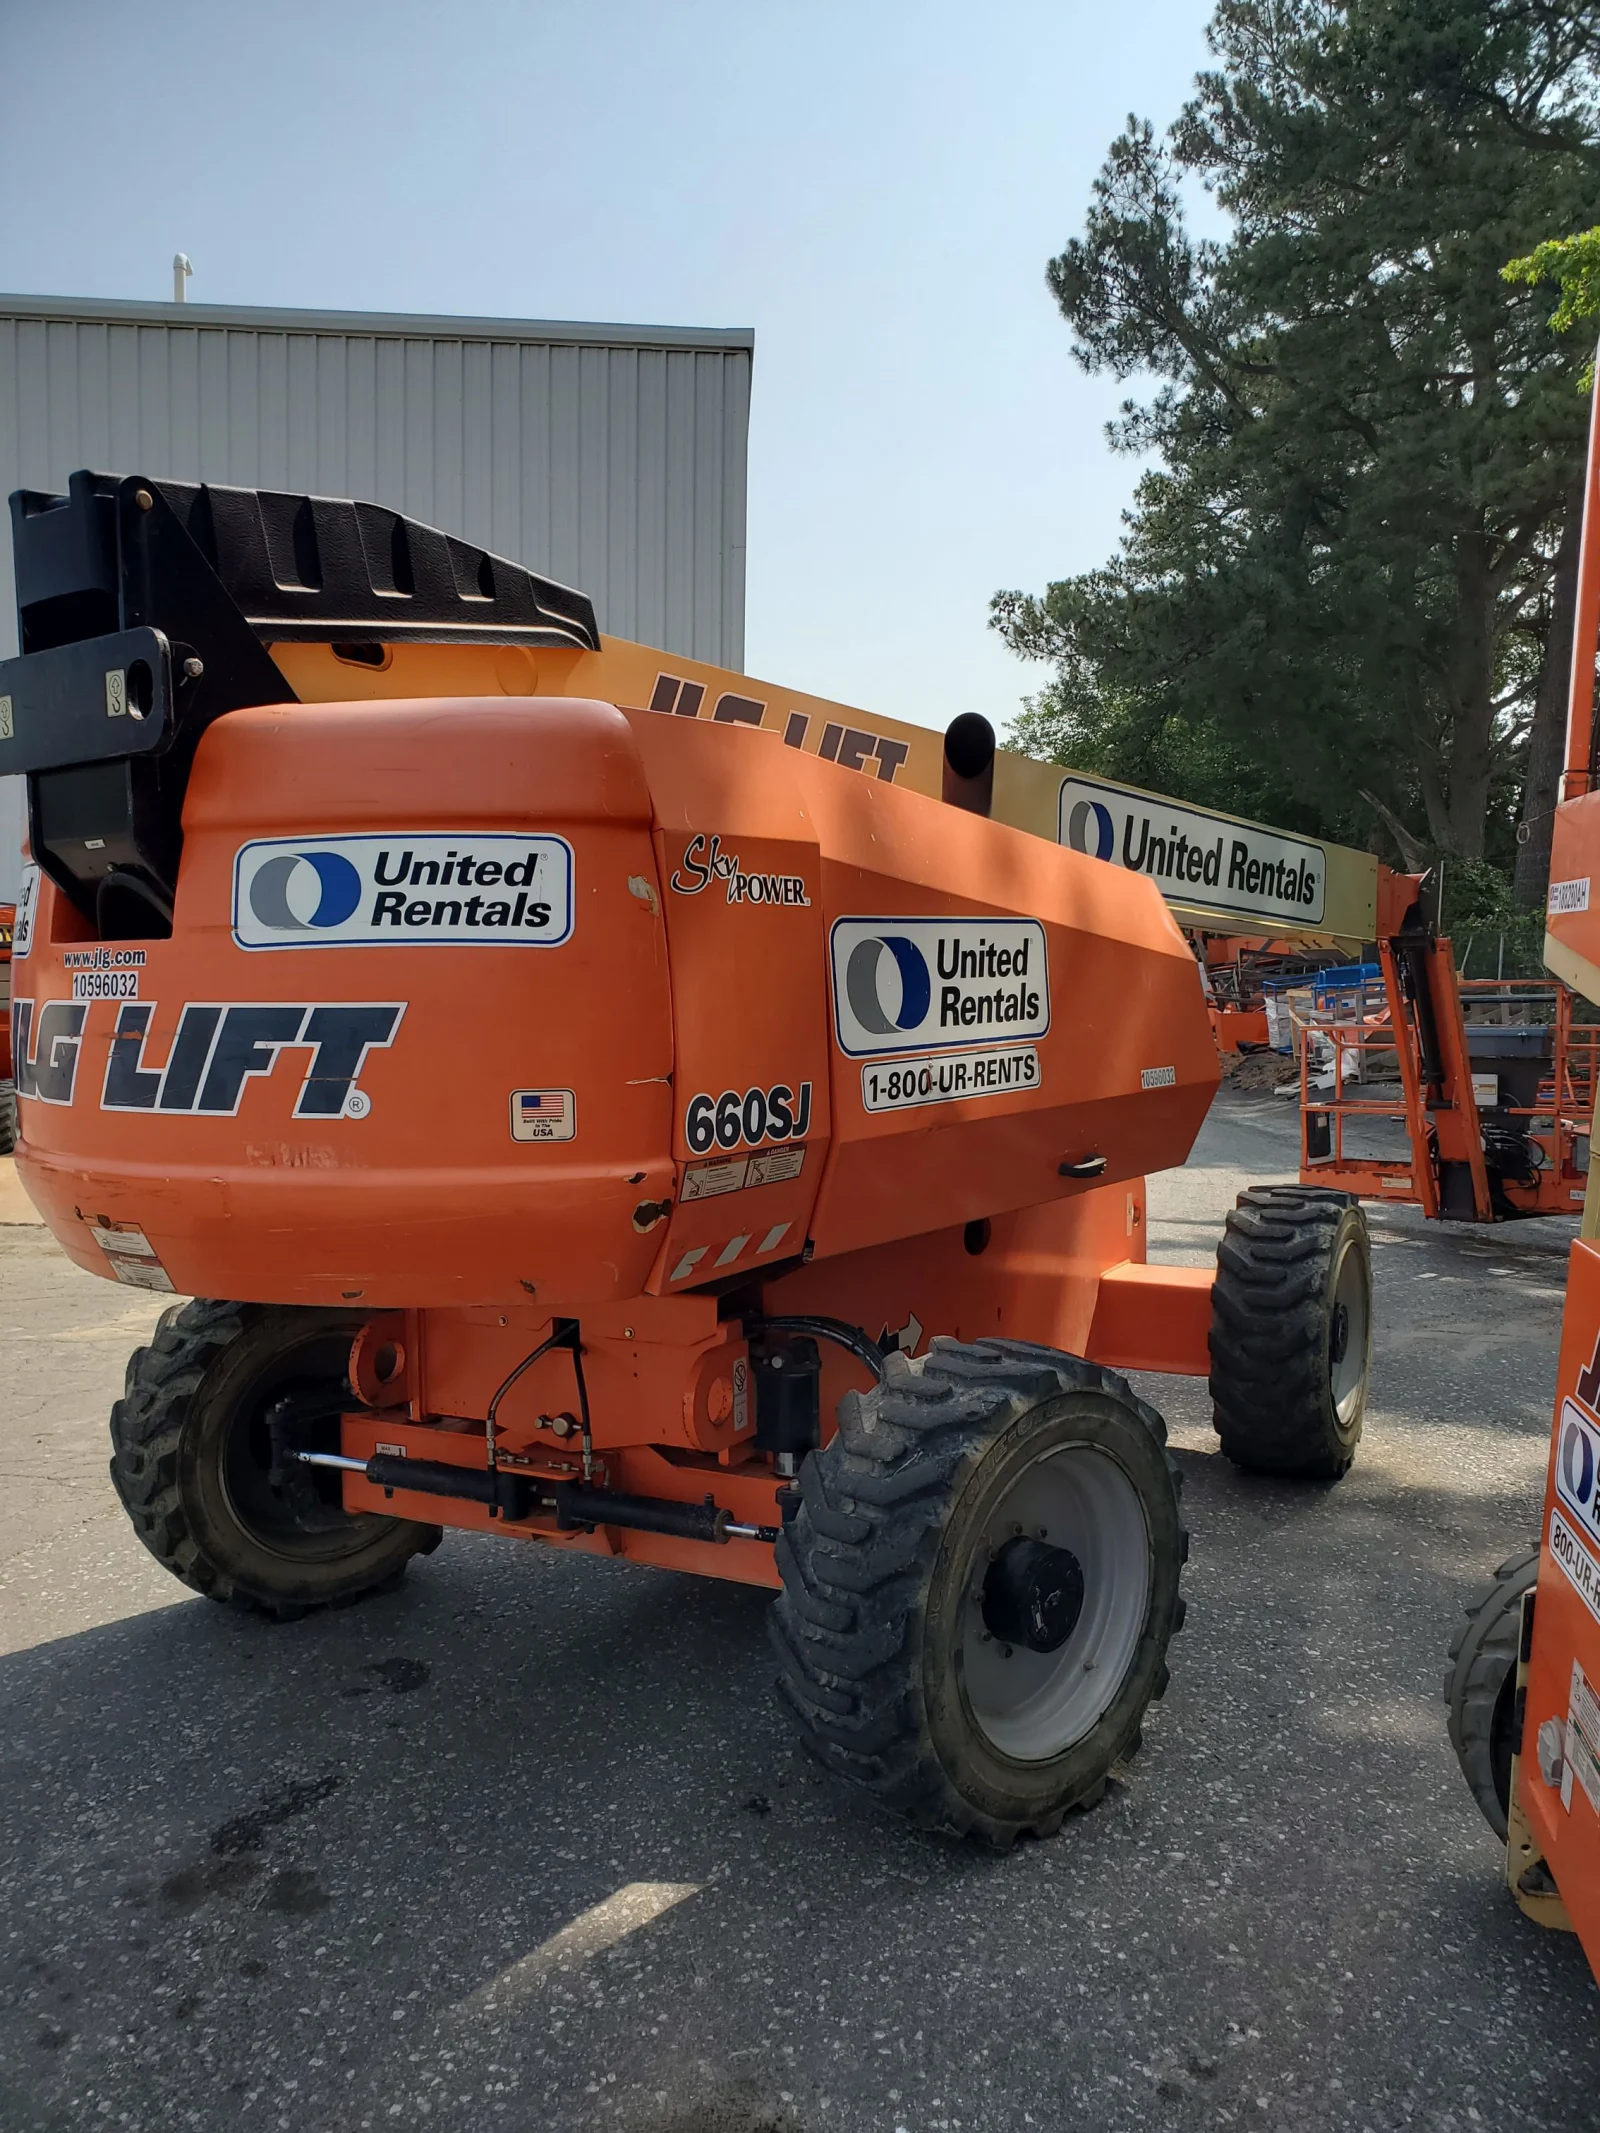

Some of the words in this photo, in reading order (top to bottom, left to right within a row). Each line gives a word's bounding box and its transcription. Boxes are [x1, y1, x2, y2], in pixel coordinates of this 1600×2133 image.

[373, 851, 538, 887] United
[671, 834, 739, 904] Sky
[735, 873, 807, 905] POWER
[1122, 814, 1223, 887] United
[1227, 840, 1315, 905] Rentals
[371, 892, 552, 928] Rentals
[64, 947, 146, 970] www.jlg.com
[937, 938, 1029, 980] United
[73, 973, 137, 997] 10596032
[940, 983, 1040, 1028] Rentals
[101, 1002, 408, 1119] LIFT
[869, 1054, 1036, 1102] 1-800-UR-RENTS
[686, 1082, 812, 1154] 660SJ
